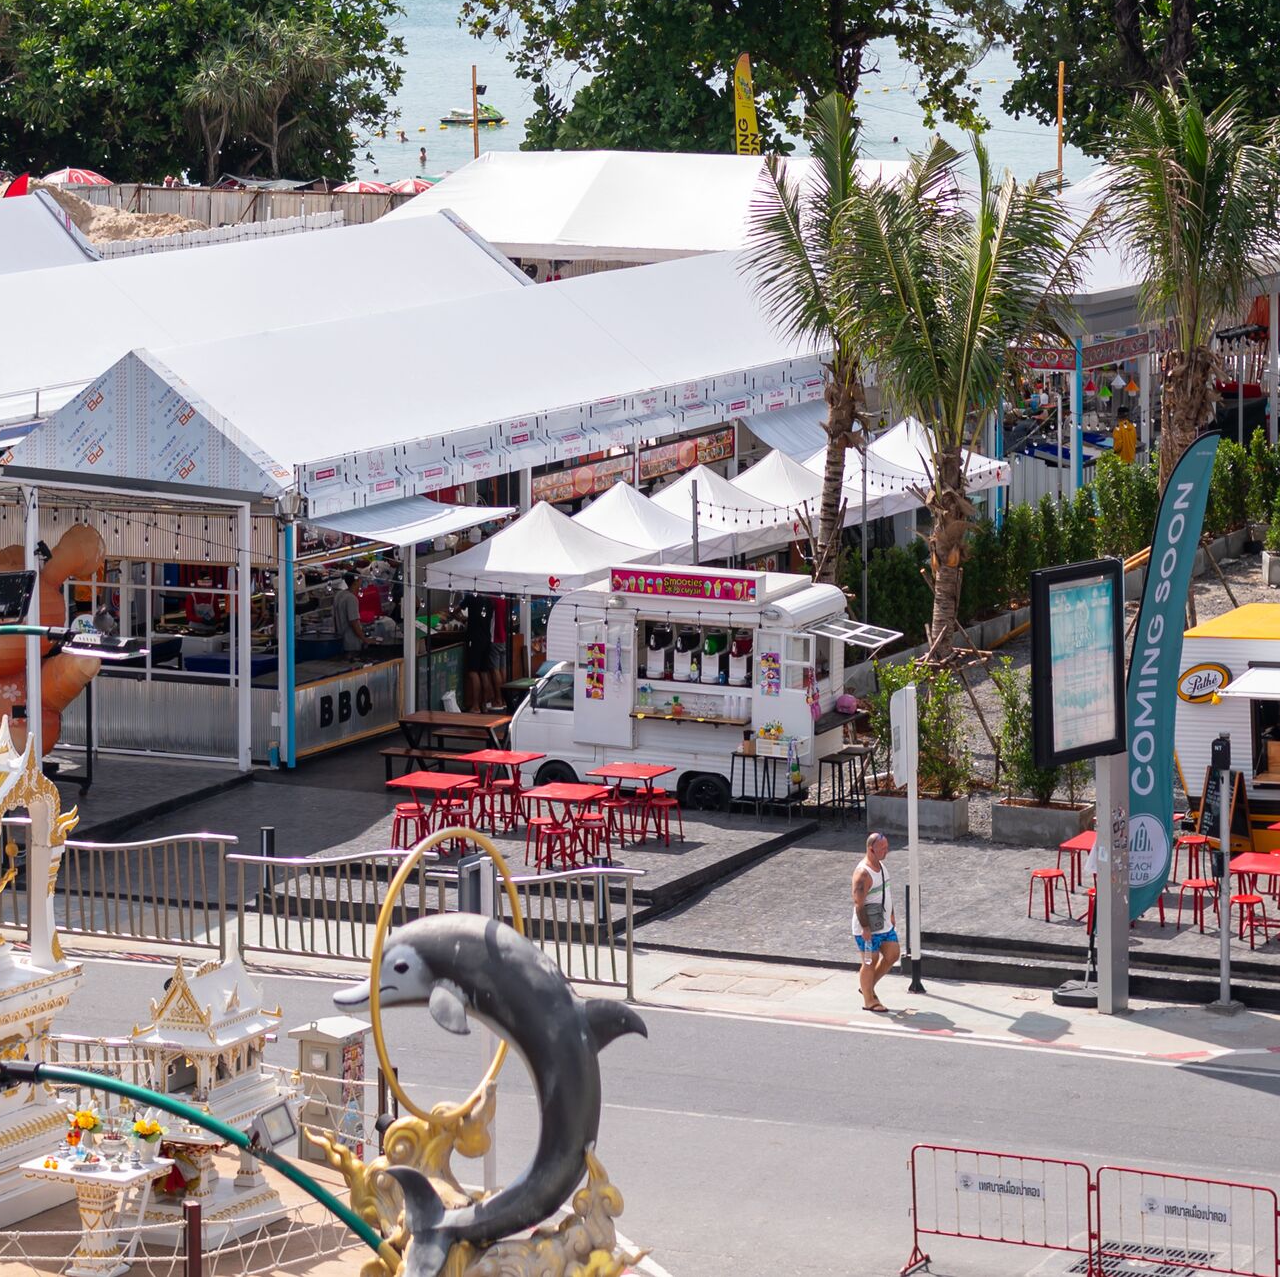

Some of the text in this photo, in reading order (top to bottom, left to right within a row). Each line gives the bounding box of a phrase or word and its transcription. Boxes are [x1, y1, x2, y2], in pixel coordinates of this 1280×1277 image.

[1131, 482, 1194, 796] COMING SOON
[320, 685, 373, 728] BBQ
[1129, 863, 1152, 871] EACH
[1130, 873, 1149, 881] LUB
